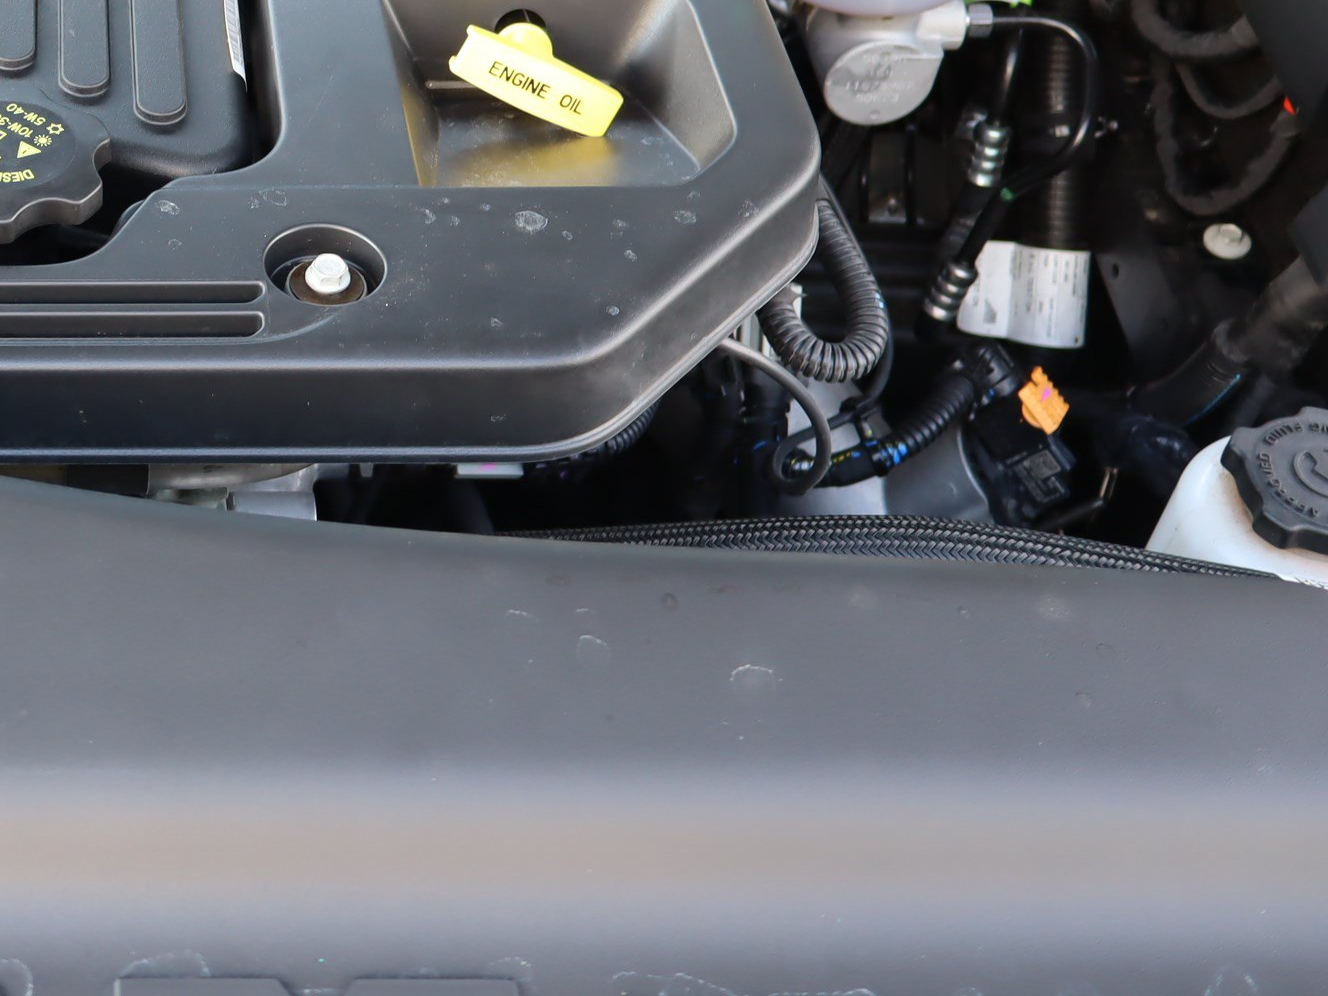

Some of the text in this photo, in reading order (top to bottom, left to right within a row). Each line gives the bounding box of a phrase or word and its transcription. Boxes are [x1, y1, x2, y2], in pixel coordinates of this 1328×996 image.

[488, 61, 583, 115] ENGINE OIL
[6, 103, 46, 126] 5W-40
